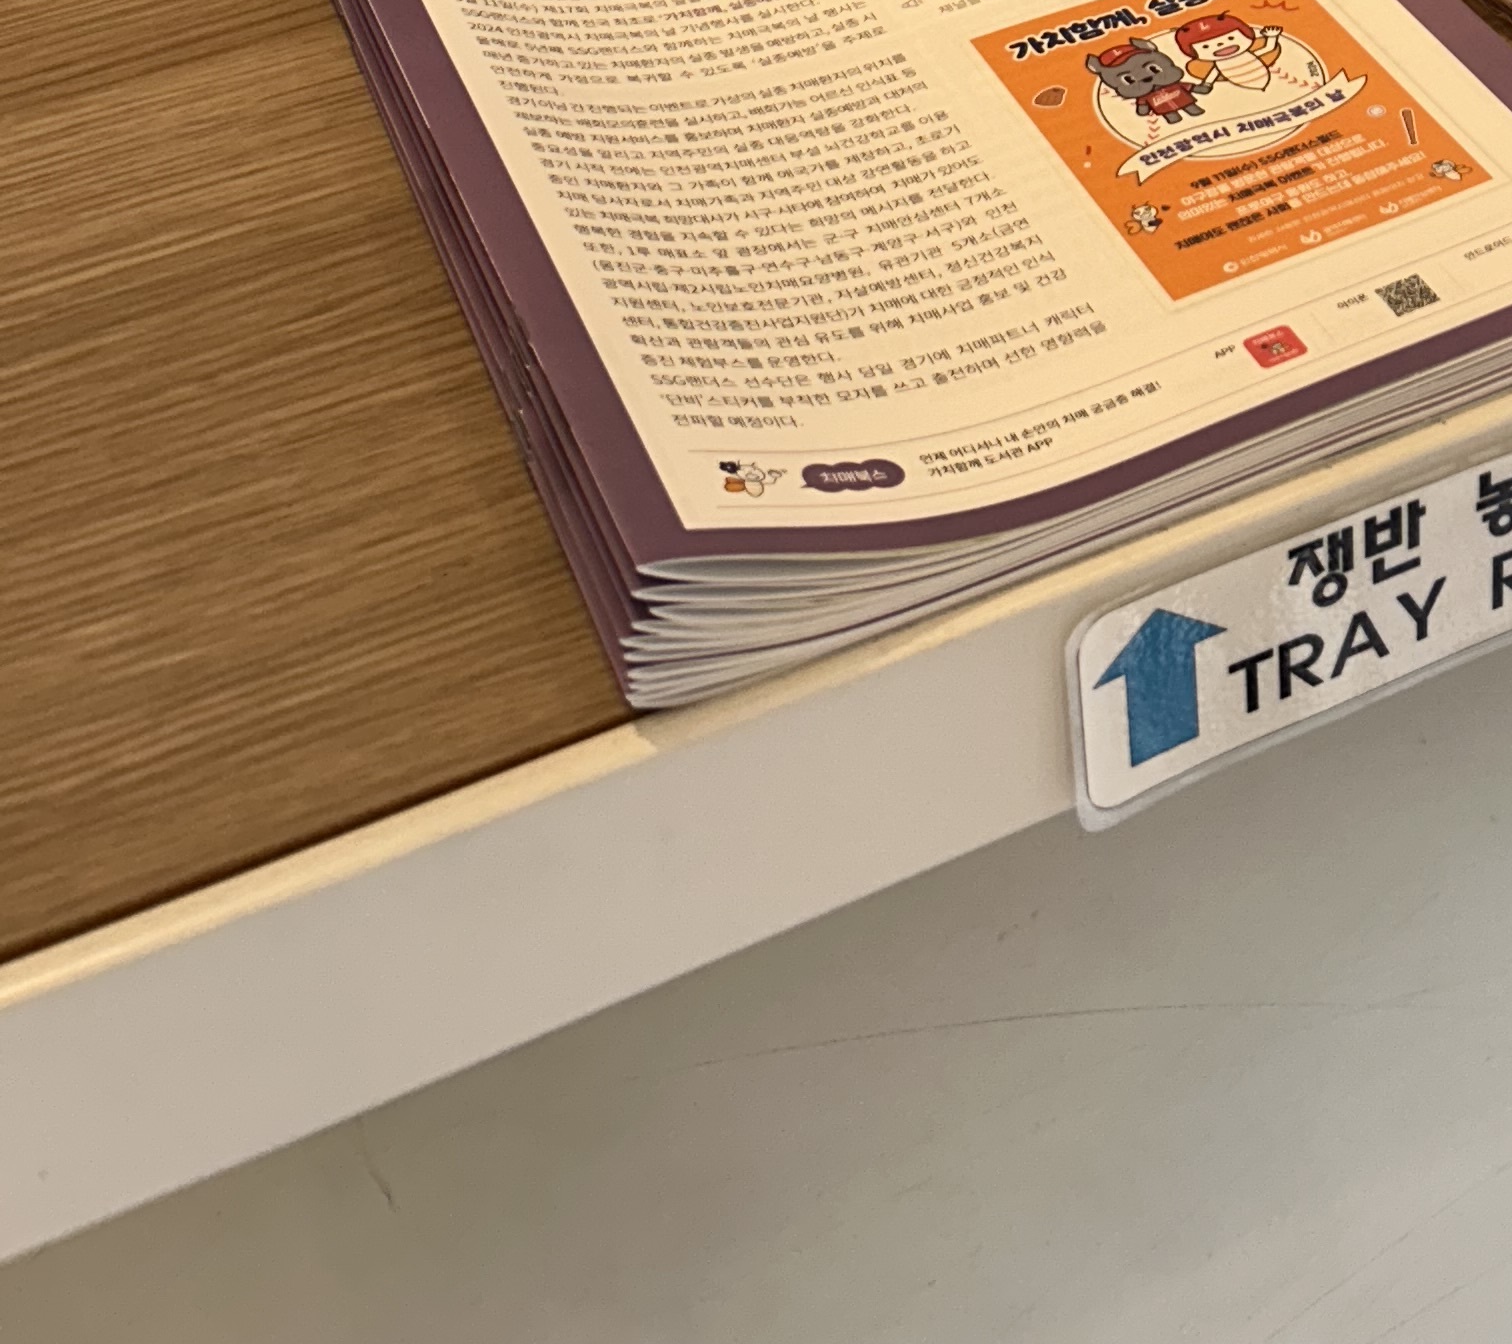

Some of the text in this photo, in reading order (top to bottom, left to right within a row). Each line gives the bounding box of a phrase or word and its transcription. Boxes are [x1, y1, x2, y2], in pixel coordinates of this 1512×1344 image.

[1010, 2, 1147, 59] 가치함께,
[1140, 87, 1346, 166] 인천광역시 치매극복의 날
[1337, 293, 1369, 311] 아이폰
[650, 302, 1095, 388] SSG랜더스 선수단은 행사 당일 경기에 치매파트너 캐릭터
[1214, 344, 1236, 359] APP
[919, 380, 1161, 465] 언제 어디서나 내 손안의 치매 궁금증 해결!
[820, 468, 888, 484] 치매북스
[927, 438, 1053, 478] 가치함께 도서관 APP
[1288, 498, 1428, 609] 쟁반
[1228, 577, 1447, 715] TRAY
